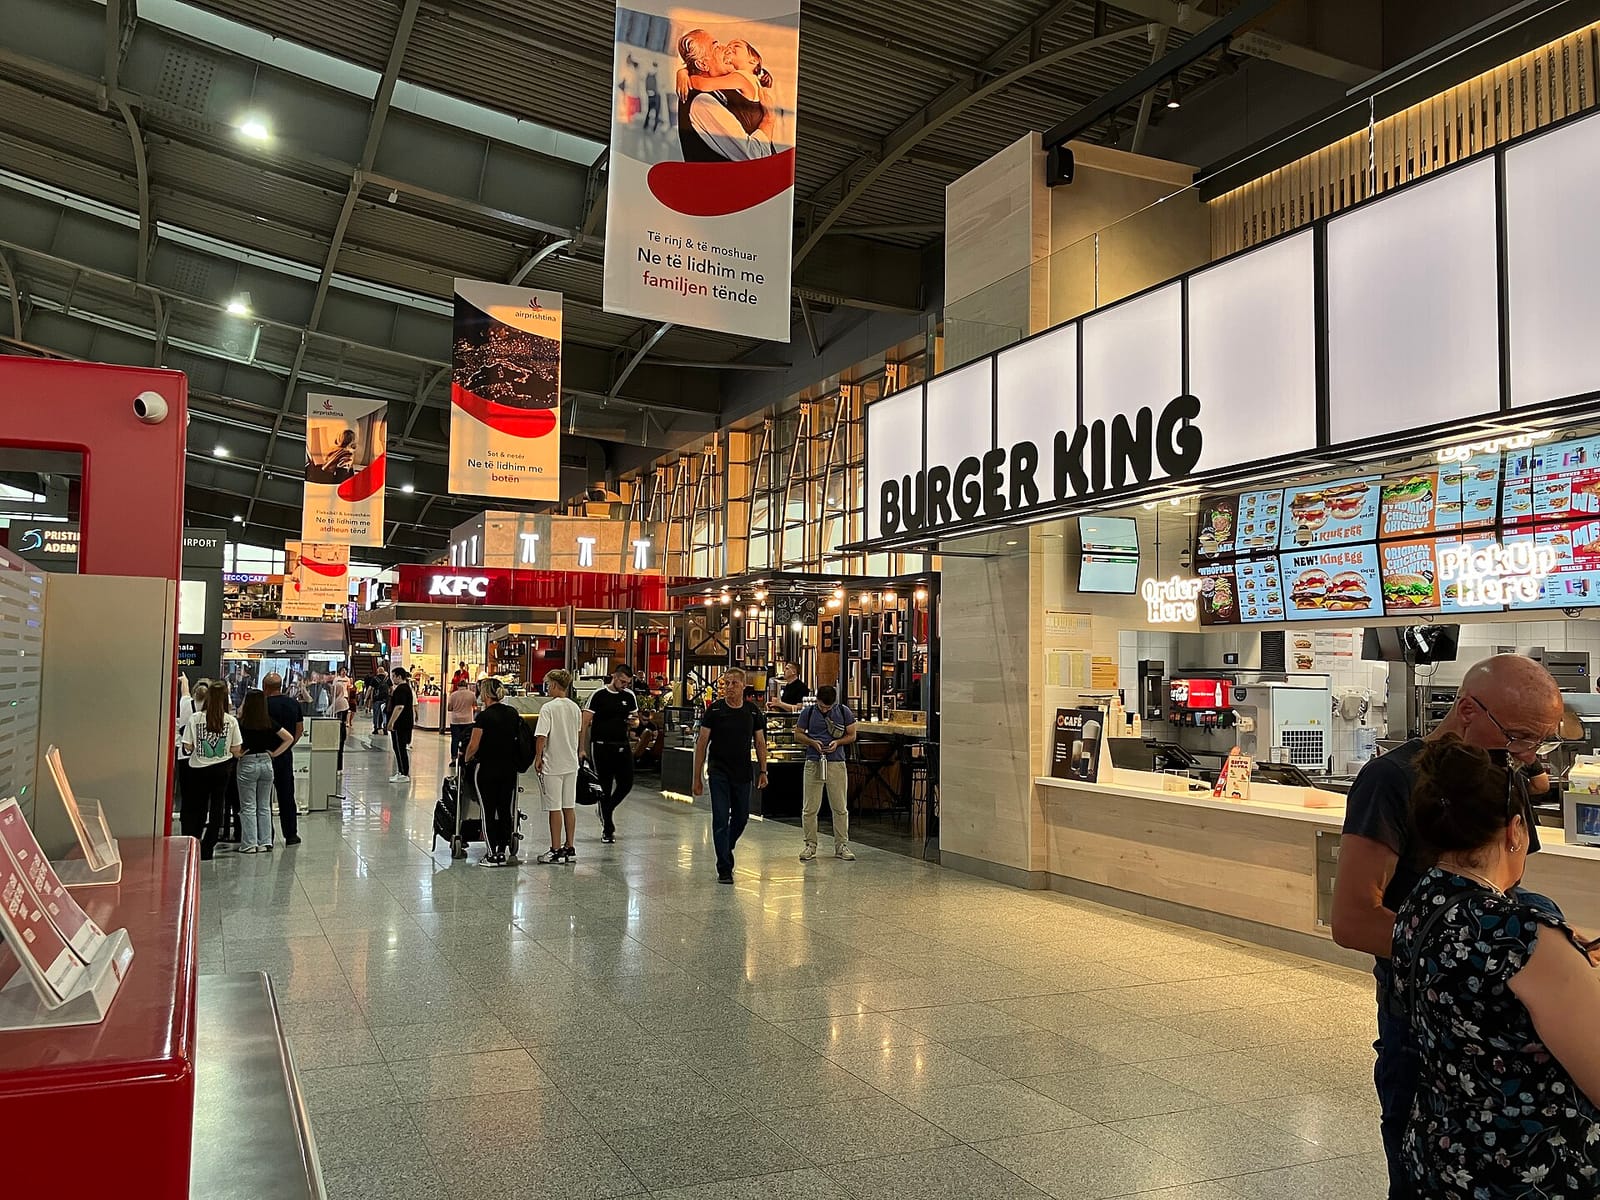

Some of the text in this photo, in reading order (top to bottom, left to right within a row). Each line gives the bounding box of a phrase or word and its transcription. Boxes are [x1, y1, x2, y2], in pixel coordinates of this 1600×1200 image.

[647, 230, 758, 262] Të rinj & të moshuar
[638, 247, 765, 285] Ne të lidhim me
[643, 270, 757, 305] familjen tënde
[515, 311, 557, 322] airprishtina
[467, 459, 482, 469] Ne
[484, 461, 494, 469] të
[496, 461, 526, 471] lidhim
[879, 394, 1203, 538] BURGER KING
[491, 472, 520, 483] botën
[44, 543, 77, 553] ADEM
[1384, 544, 1431, 560] ORIGINAL
[1293, 551, 1363, 567] NEW! King Egg
[1386, 551, 1430, 570] CHICKEN
[1198, 564, 1234, 575] WHOPPER
[428, 575, 489, 597] KFC
[1141, 575, 1202, 601] Order
[1457, 574, 1540, 606] Here
[1147, 598, 1197, 623] Here
[271, 638, 308, 646] airprishtina
[1064, 714, 1082, 727] CAFÉ
